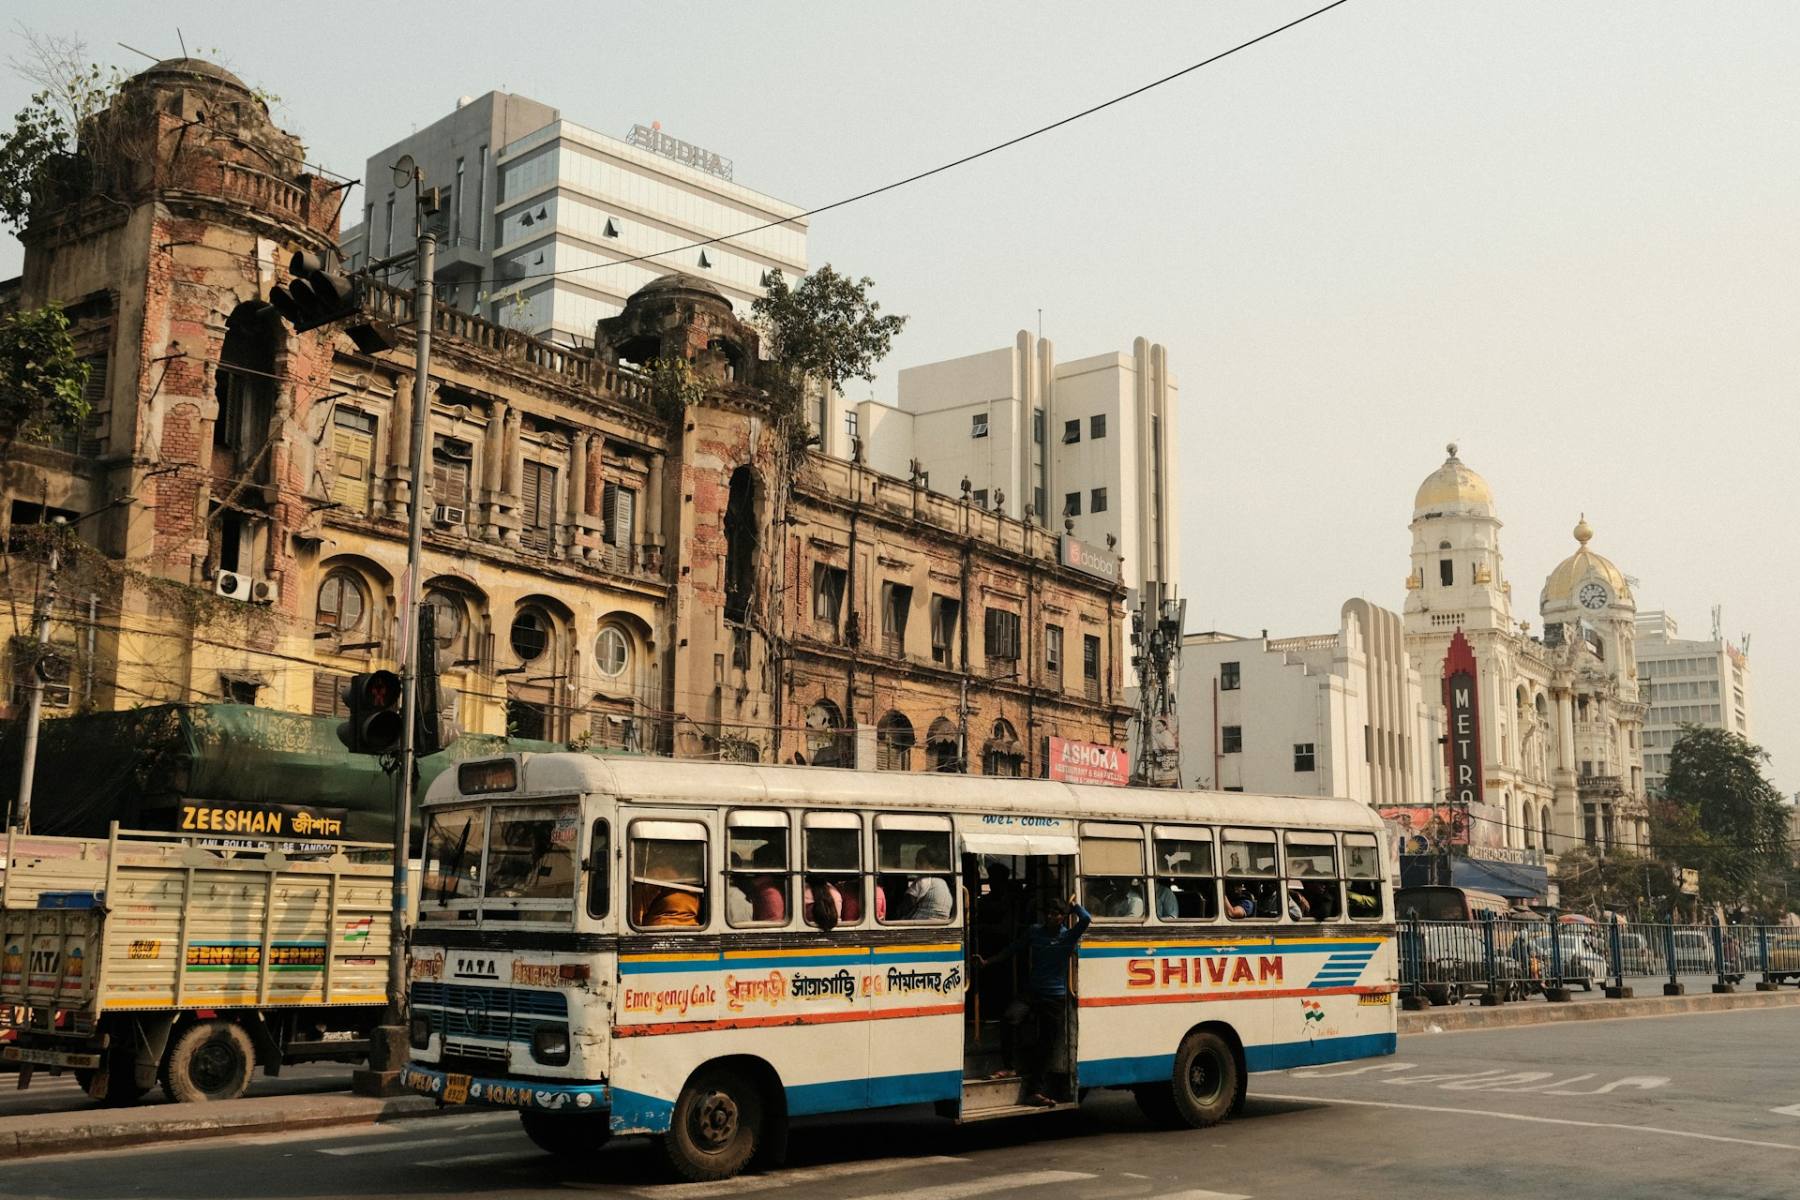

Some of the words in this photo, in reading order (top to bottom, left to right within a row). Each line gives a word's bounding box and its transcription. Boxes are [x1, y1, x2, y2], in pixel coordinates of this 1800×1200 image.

[1062, 743, 1119, 770] ASHOKA
[1456, 688, 1473, 803] METRO
[182, 806, 282, 834] ZEESHAN
[291, 811, 342, 836] জীশান
[457, 959, 495, 973] TATA
[1128, 956, 1283, 987] SHIVAM
[625, 988, 689, 1014] Emergency
[407, 1071, 433, 1091] SPEED
